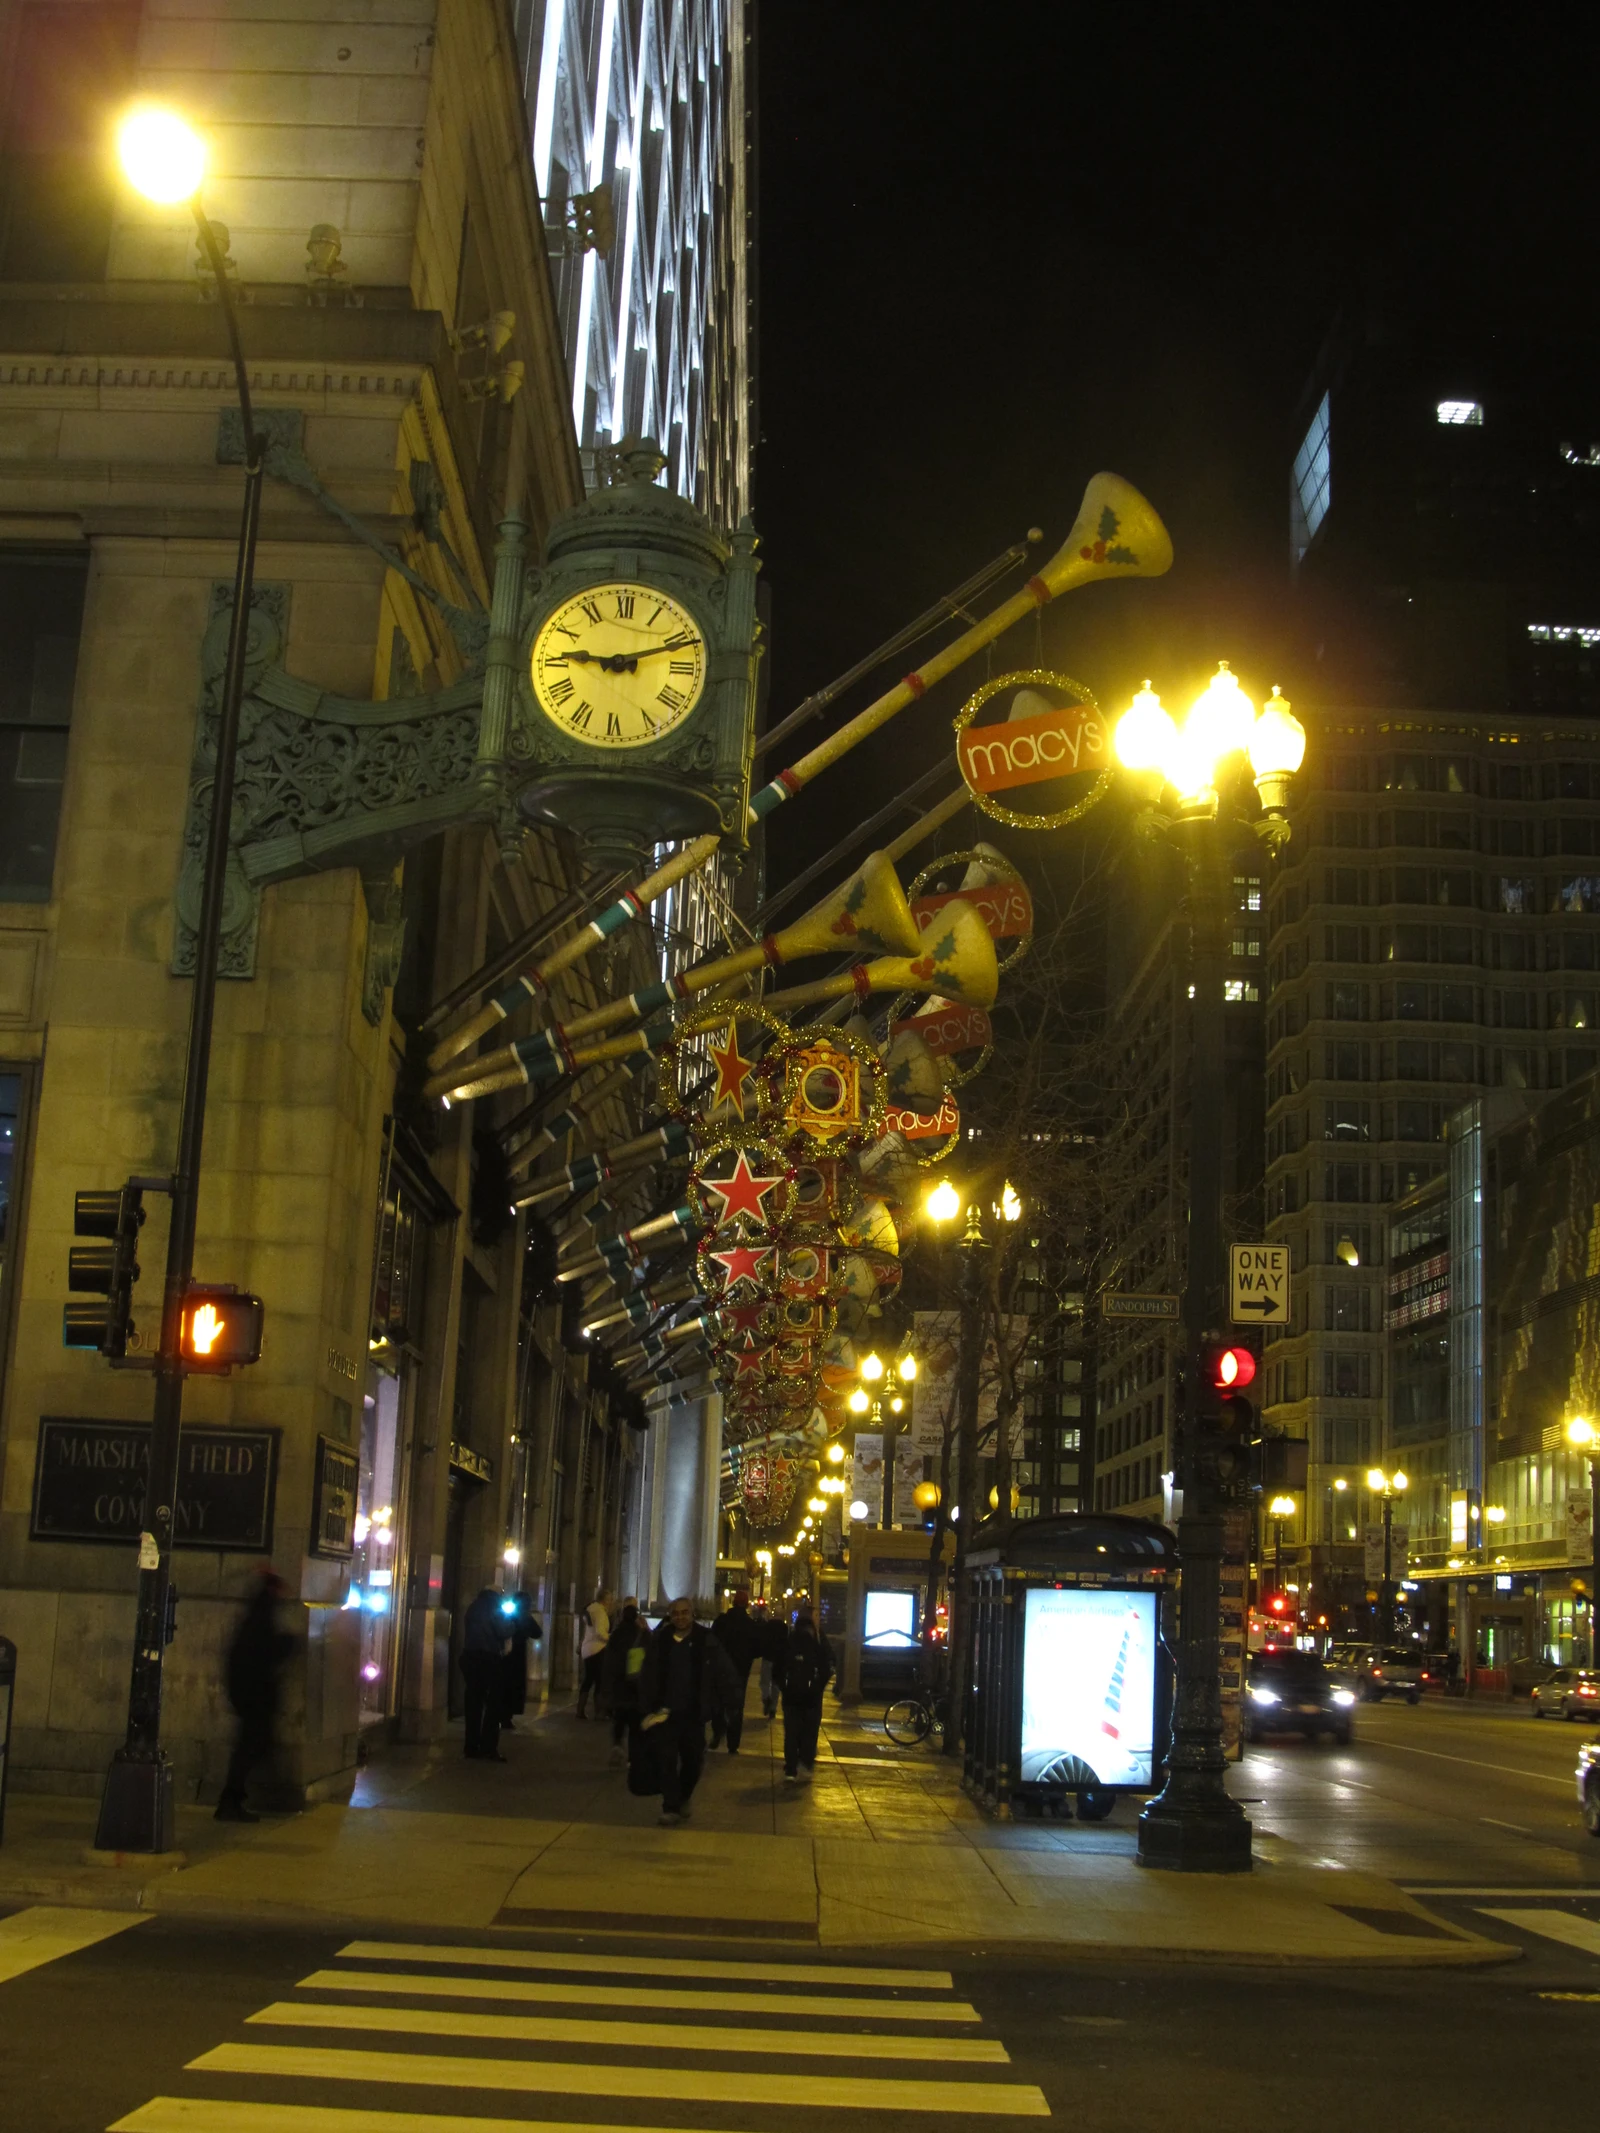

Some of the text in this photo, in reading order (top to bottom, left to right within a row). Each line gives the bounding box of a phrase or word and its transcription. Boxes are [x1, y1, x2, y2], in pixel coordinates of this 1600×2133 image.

[581, 600, 604, 627] XI
[615, 595, 635, 620] XII
[556, 623, 581, 644] X
[1239, 1251, 1282, 1270] ONE
[1238, 1273, 1283, 1292] WAY
[189, 1444, 253, 1475] FIELD
[1039, 1604, 1125, 1617] American Airlines
